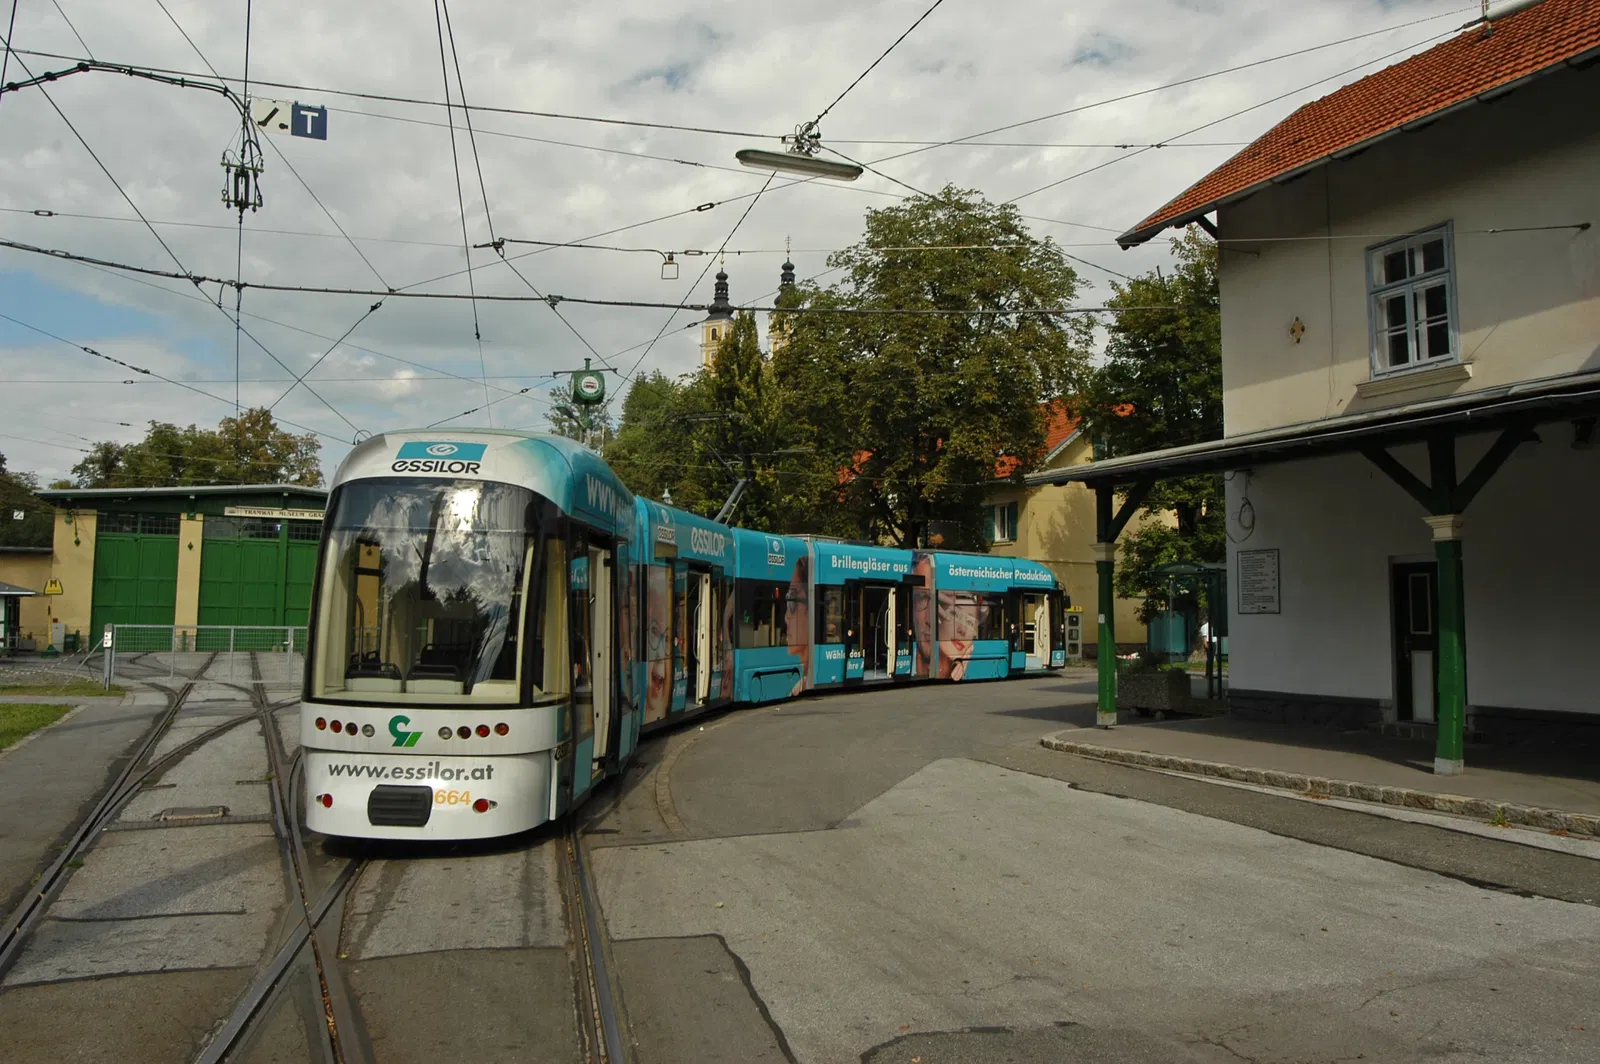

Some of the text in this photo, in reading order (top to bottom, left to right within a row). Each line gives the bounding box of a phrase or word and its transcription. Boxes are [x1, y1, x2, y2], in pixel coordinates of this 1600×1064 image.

[300, 110, 319, 134] T
[279, 510, 305, 518] MUSEUM
[831, 555, 1052, 582] Brillengläser aus österreichischer Produktion
[849, 648, 861, 658] das
[328, 761, 494, 781] www.essilor.at
[434, 789, 471, 805] 664
